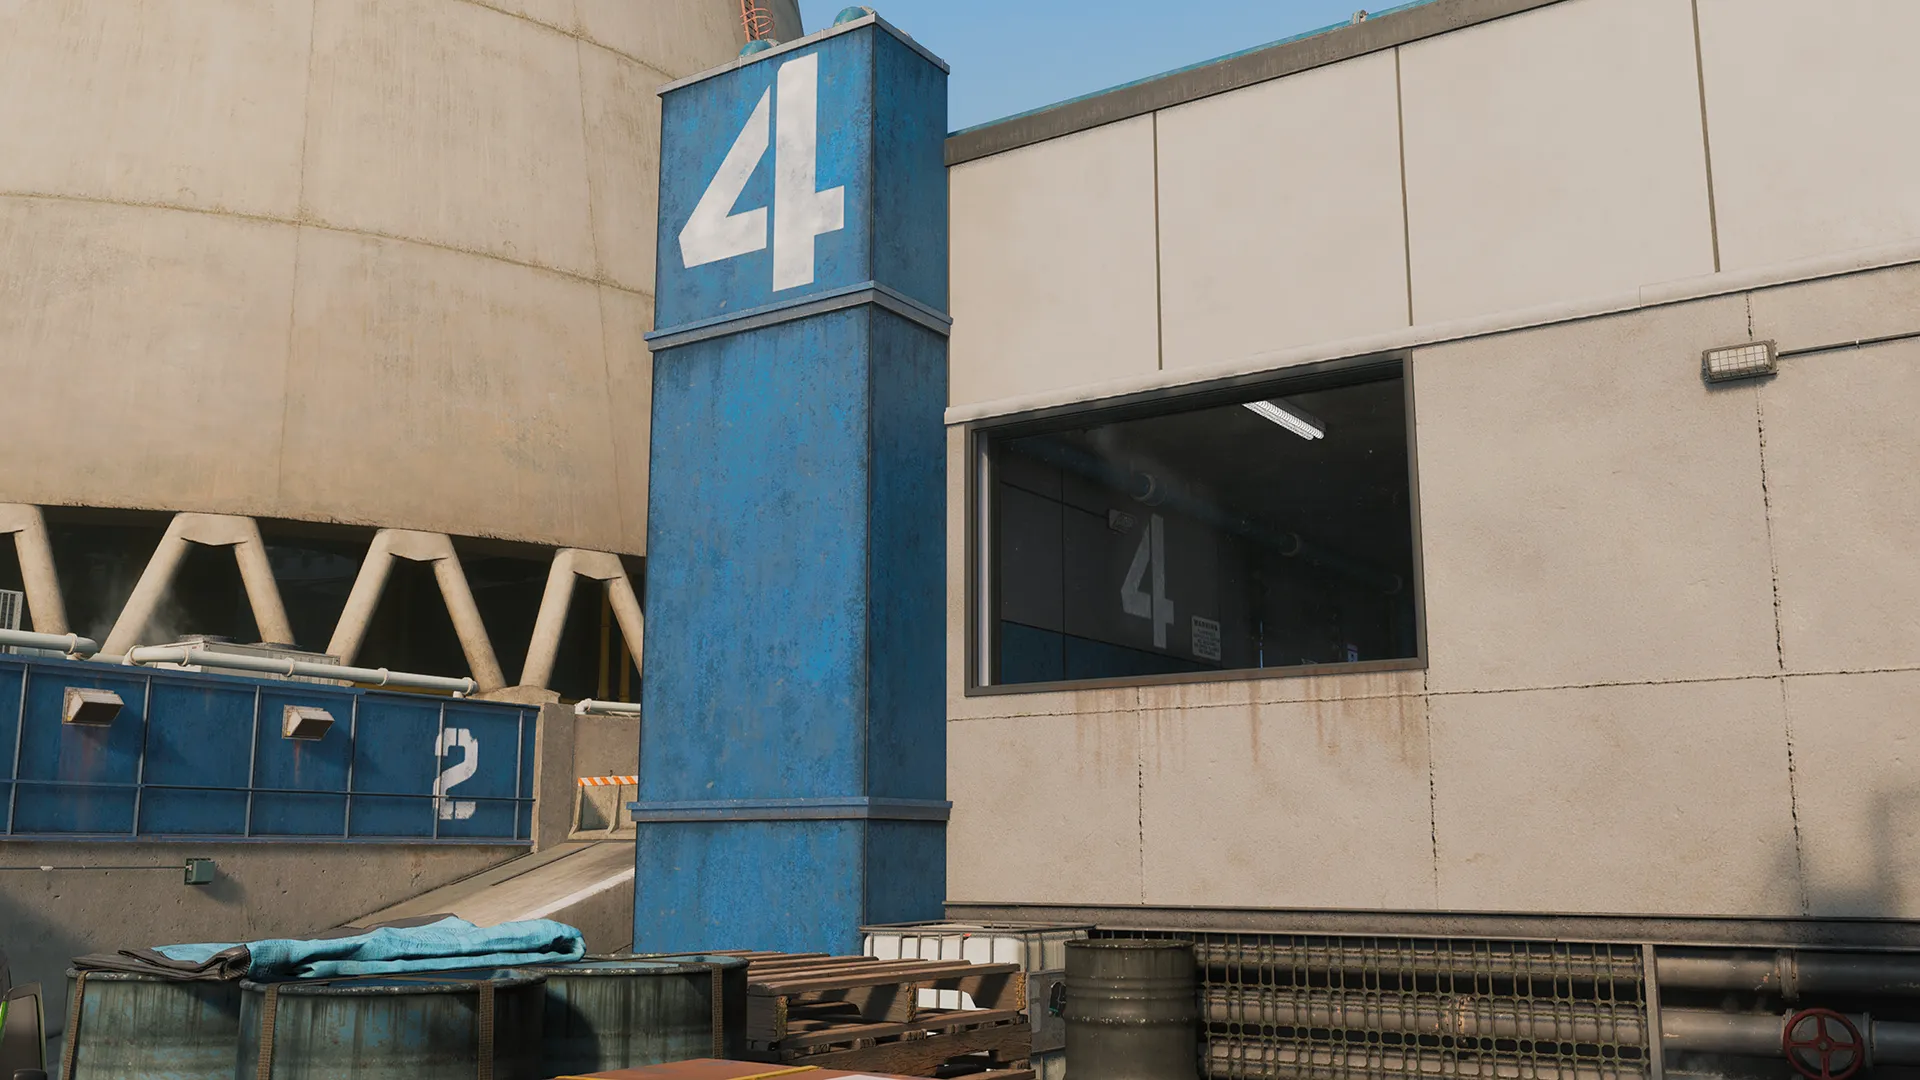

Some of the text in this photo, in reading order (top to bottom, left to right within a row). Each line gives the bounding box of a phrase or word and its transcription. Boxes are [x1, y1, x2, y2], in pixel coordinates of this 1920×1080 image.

[678, 52, 844, 292] 4
[1121, 513, 1174, 649] 4
[432, 728, 479, 820] 2
